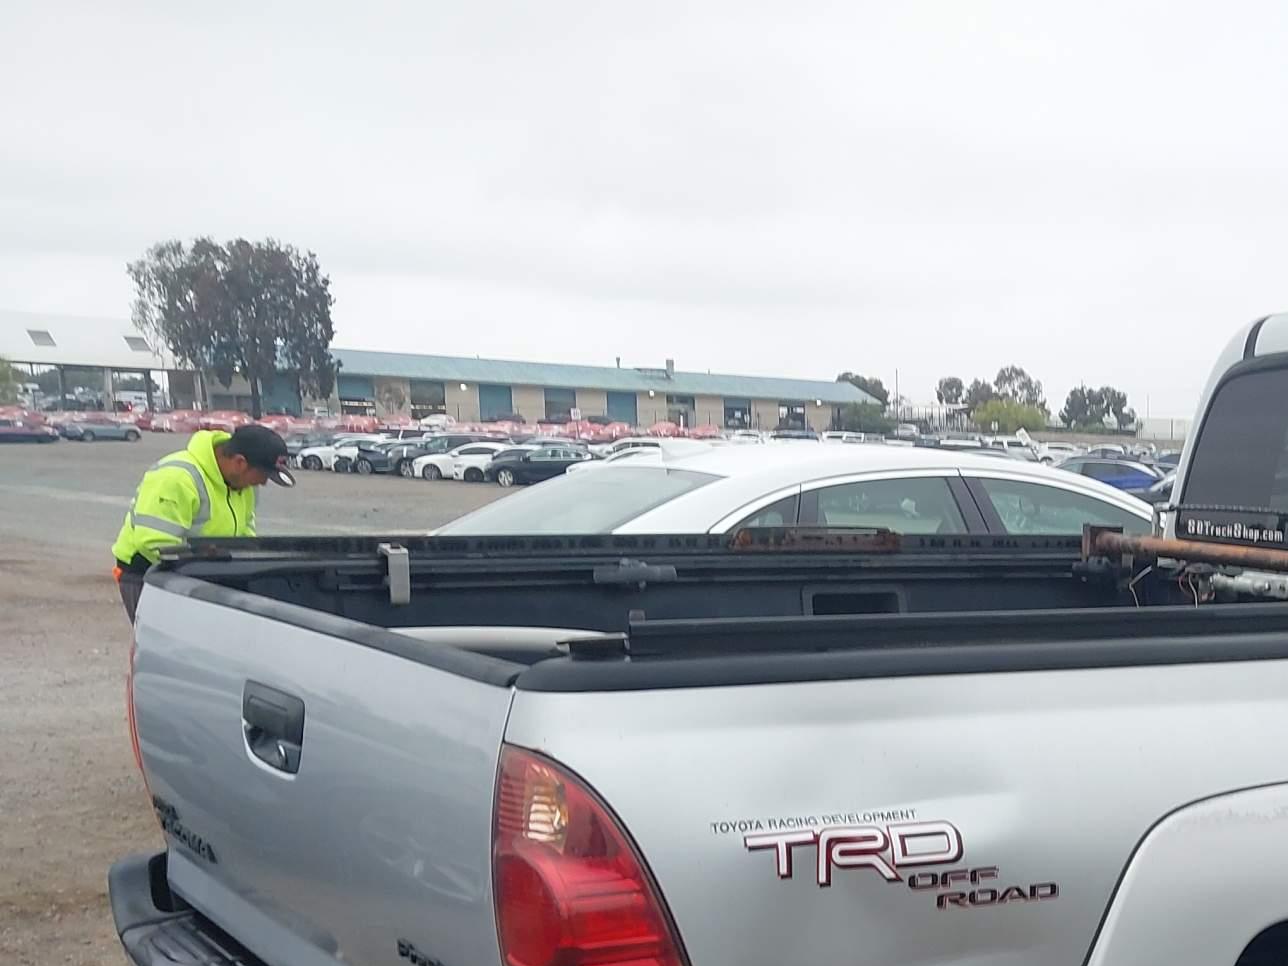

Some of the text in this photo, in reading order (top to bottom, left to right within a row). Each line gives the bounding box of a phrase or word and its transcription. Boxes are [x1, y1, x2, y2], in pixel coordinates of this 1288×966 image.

[710, 808, 918, 835] TOYOTA RACING DEVELOPMENT
[743, 820, 964, 888] TRD
[907, 865, 1000, 890] OFF
[936, 881, 1060, 911] ROAD
